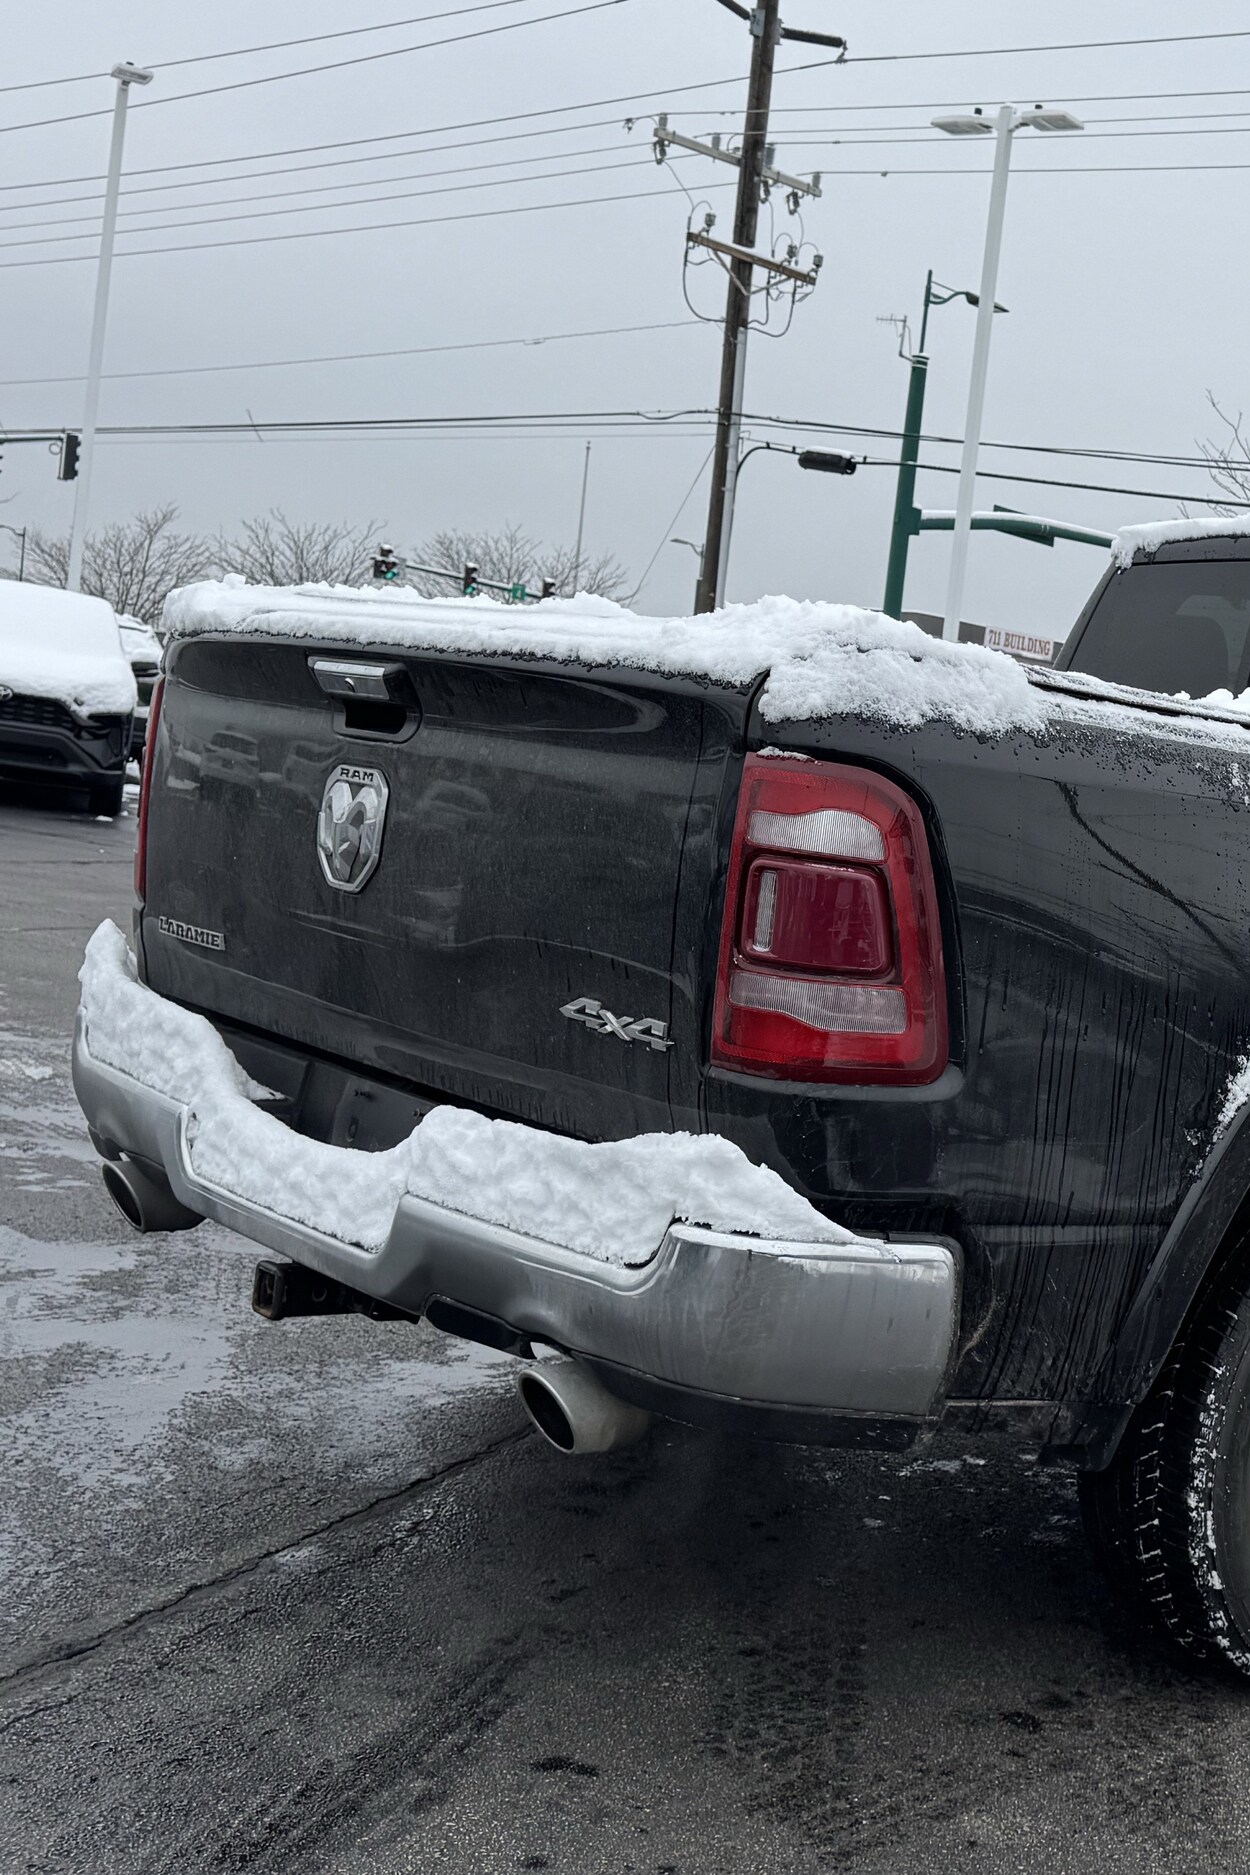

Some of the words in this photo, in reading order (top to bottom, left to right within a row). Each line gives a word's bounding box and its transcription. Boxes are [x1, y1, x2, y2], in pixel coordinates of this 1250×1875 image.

[988, 629, 1001, 646] 711
[1003, 631, 1051, 656] BUILDING
[340, 766, 374, 782] RAM
[159, 916, 224, 950] LARAMIE
